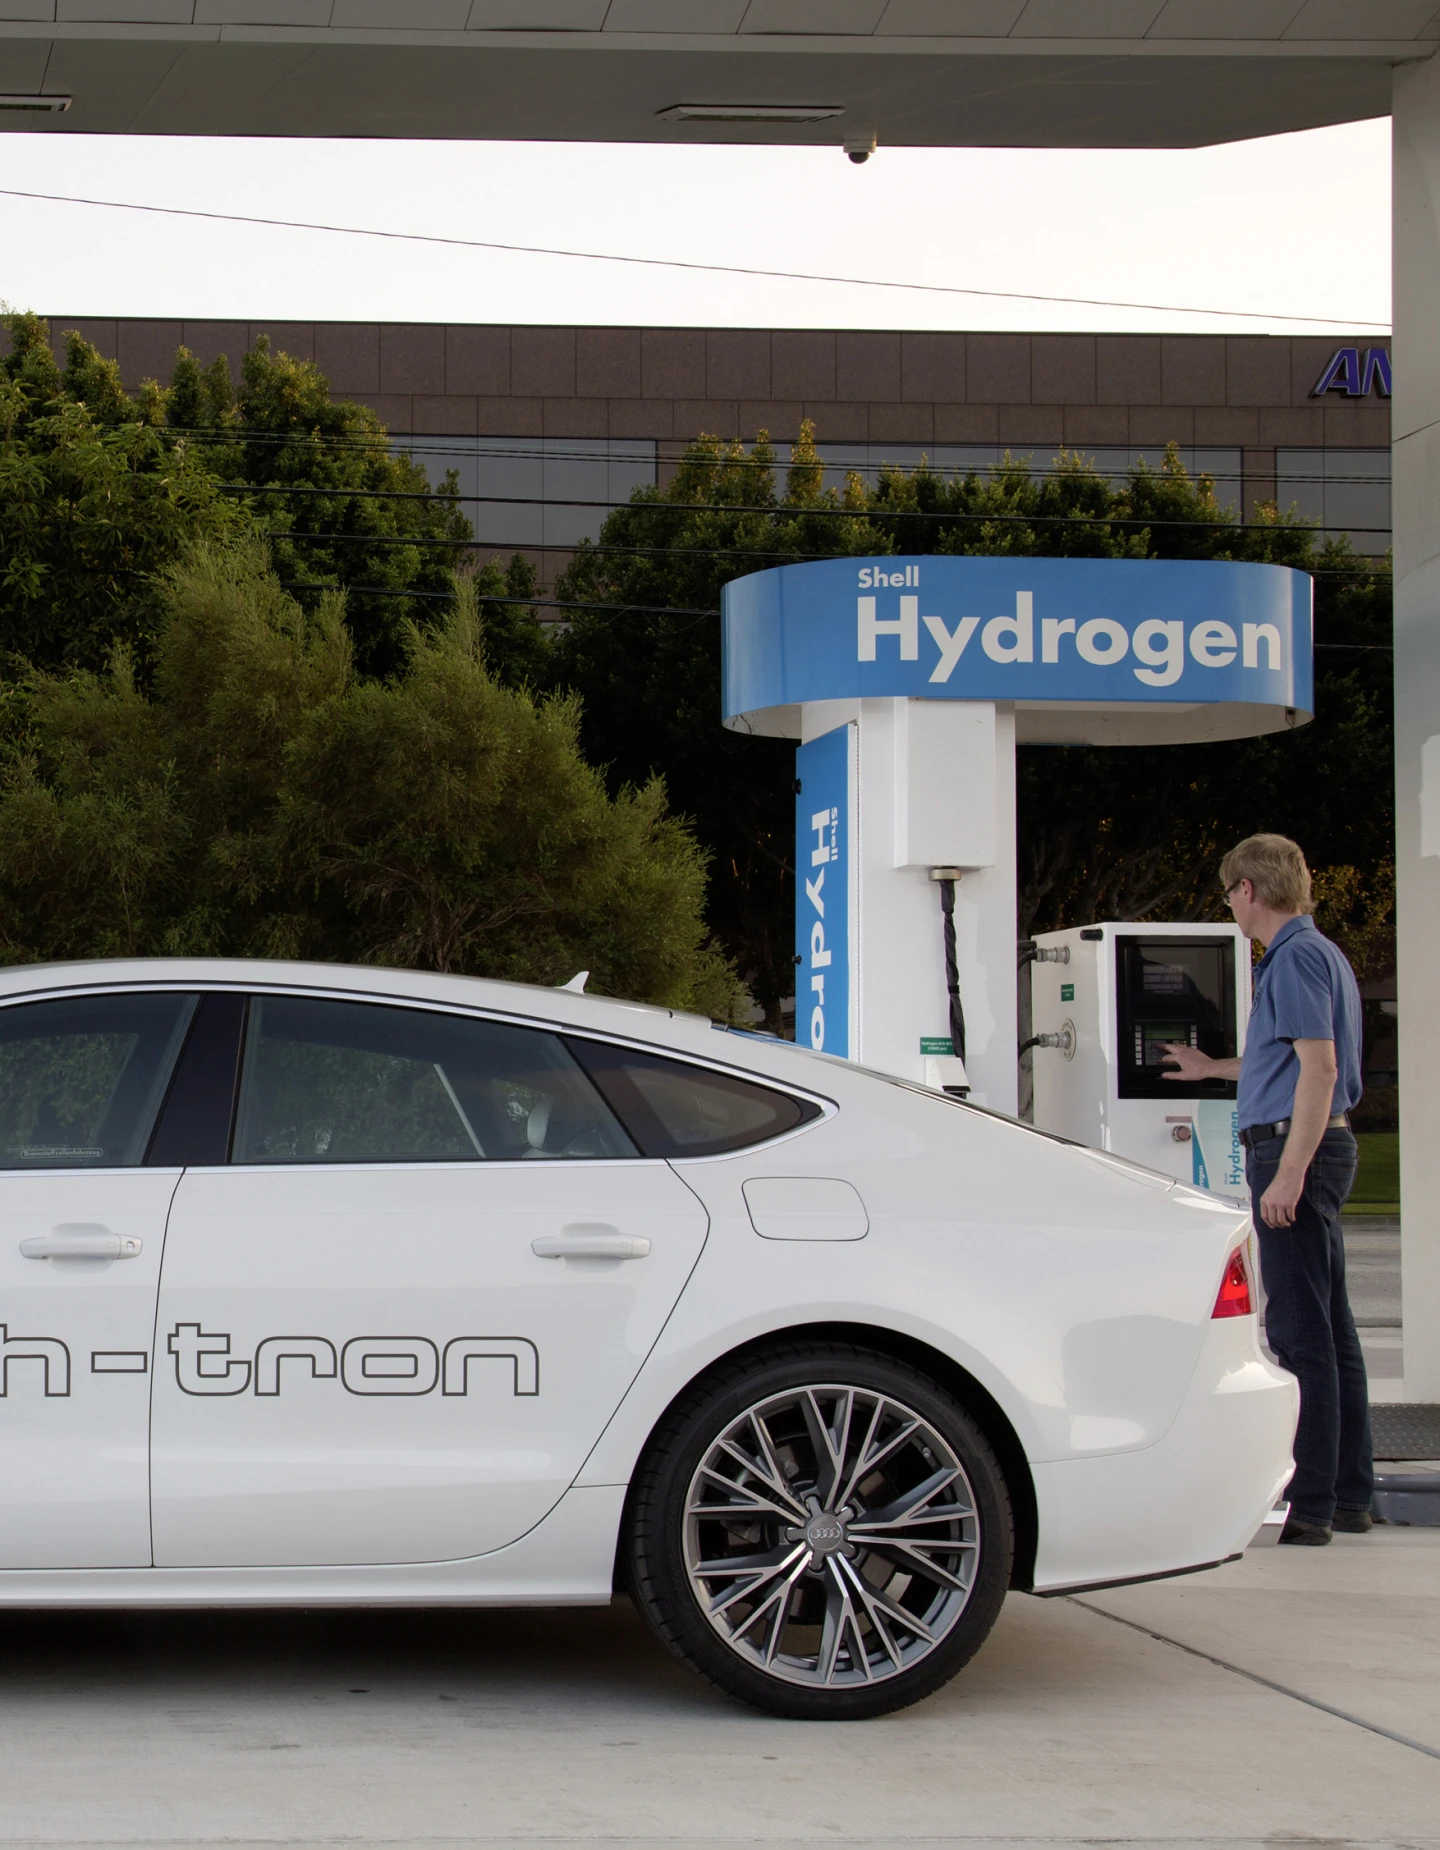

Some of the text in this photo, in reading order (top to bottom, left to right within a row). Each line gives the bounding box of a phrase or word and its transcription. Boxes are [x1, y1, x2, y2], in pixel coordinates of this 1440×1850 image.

[857, 565, 919, 588] Shell
[857, 590, 1281, 687] Hydrogen
[830, 806, 838, 861] Shell
[805, 808, 832, 1051] Hydro
